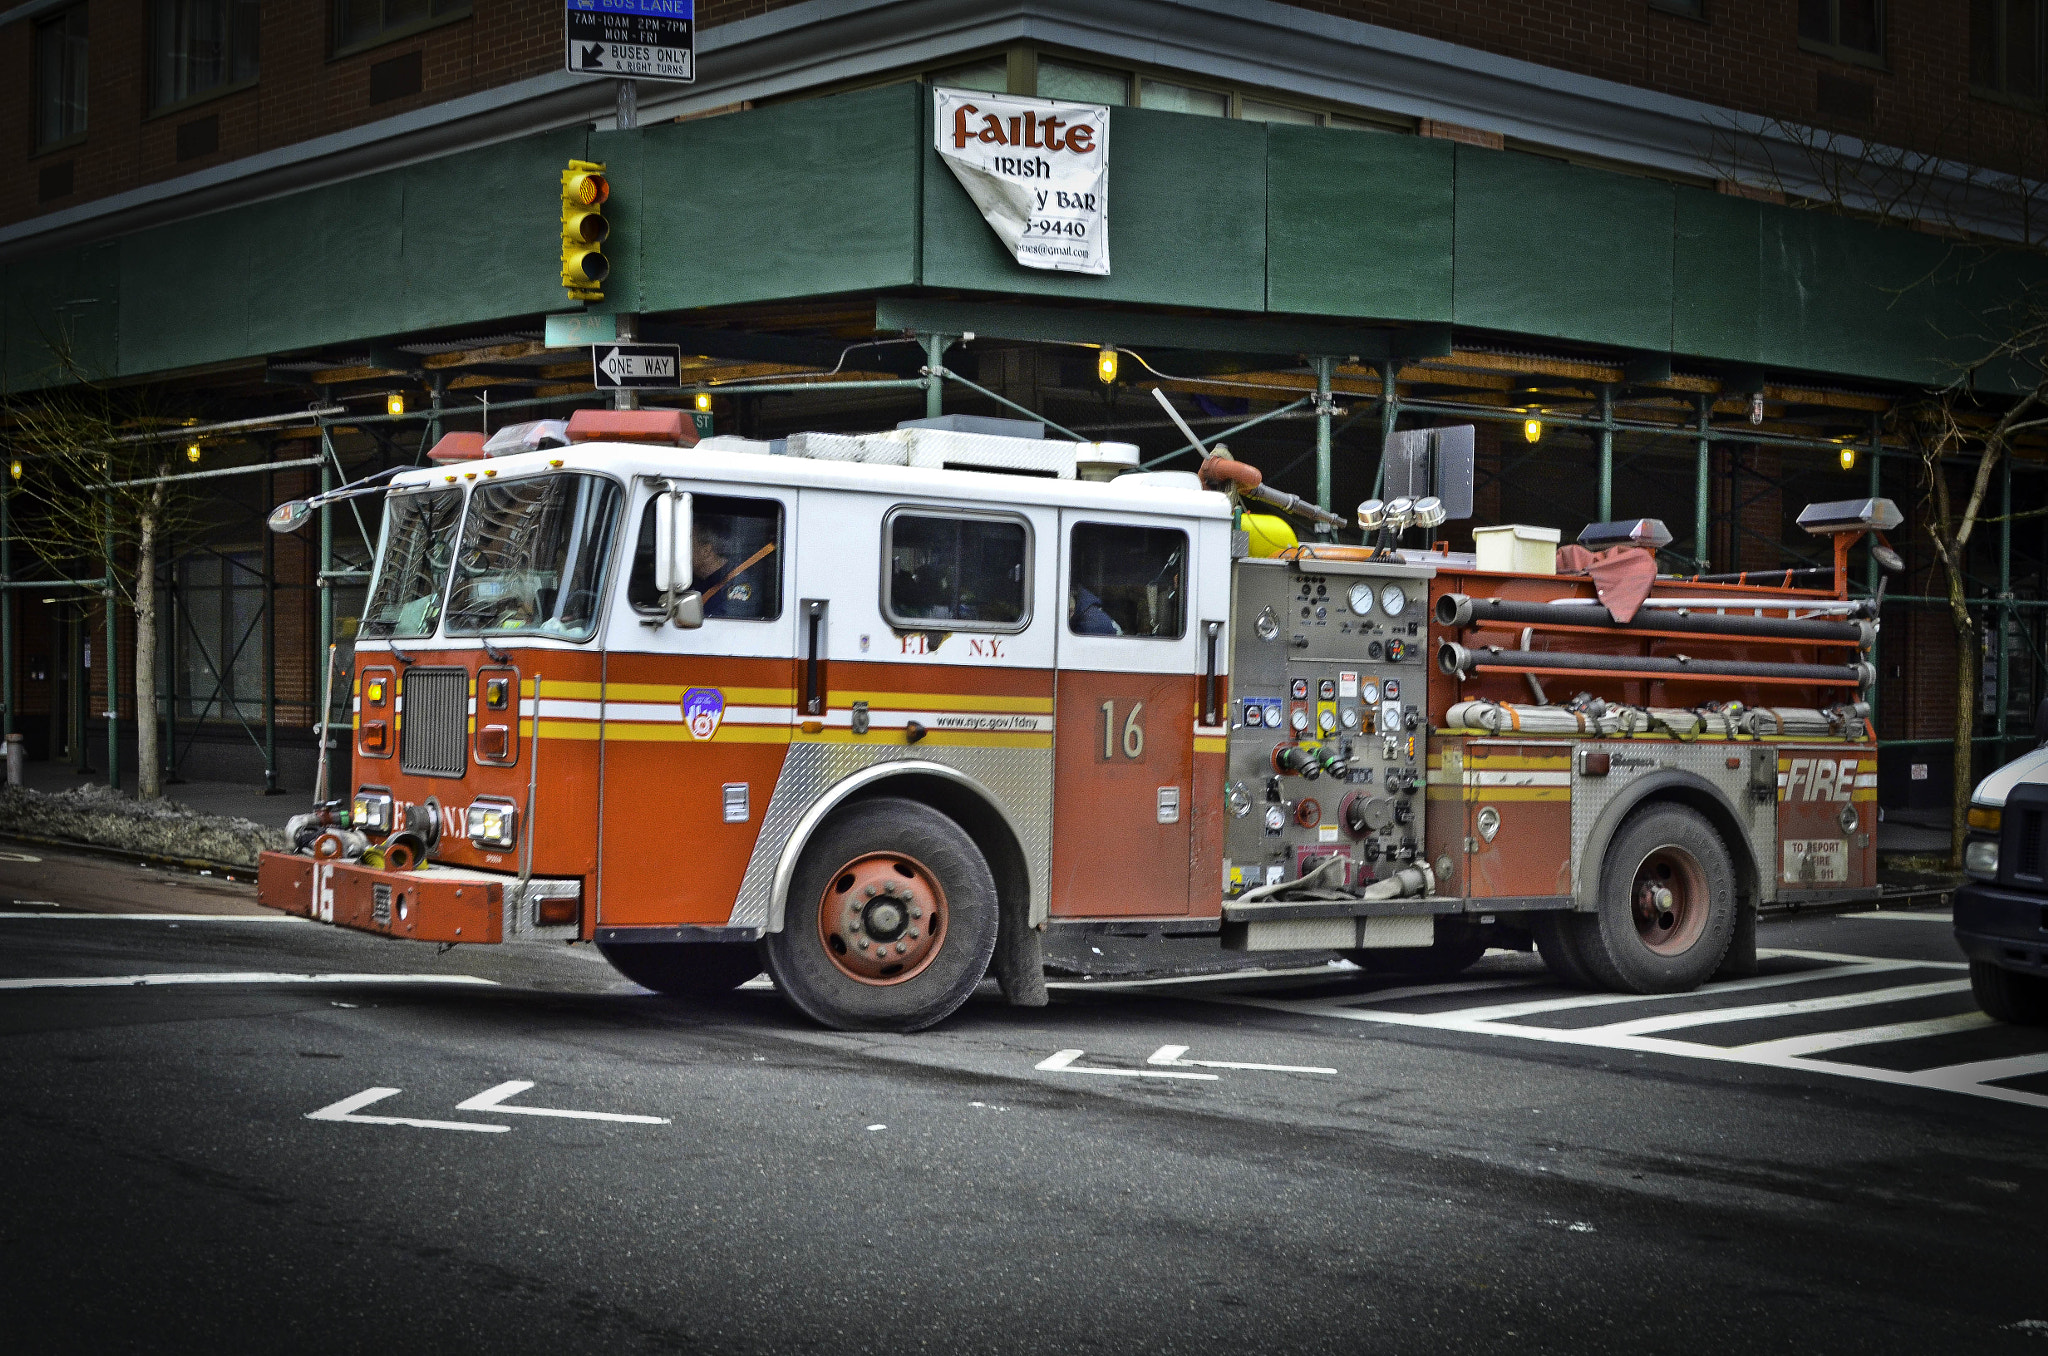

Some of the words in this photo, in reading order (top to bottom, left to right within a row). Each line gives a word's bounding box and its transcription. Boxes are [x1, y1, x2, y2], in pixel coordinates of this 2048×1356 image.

[603, 0, 635, 9] BUS
[641, 0, 684, 14] LANE
[605, 28, 628, 41] MON
[640, 31, 658, 44] FRI
[611, 45, 650, 60] BUSES
[657, 50, 687, 64] ONLY
[616, 61, 623, 70] &
[627, 61, 652, 73] RIGHT
[657, 64, 683, 75] TURNS
[1056, 191, 1097, 213] BAR
[568, 317, 581, 341] 2
[608, 358, 633, 375] ONE
[644, 358, 669, 375] WAY
[696, 415, 710, 428] ST
[968, 639, 1005, 658] N.Y.
[936, 715, 1039, 731] www.nyc.gov/fdny
[1101, 700, 1144, 760] 16
[1784, 759, 1859, 801] FIRE
[1792, 842, 1803, 853] TO
[1806, 842, 1840, 853] REPORT
[312, 861, 334, 923] 16
